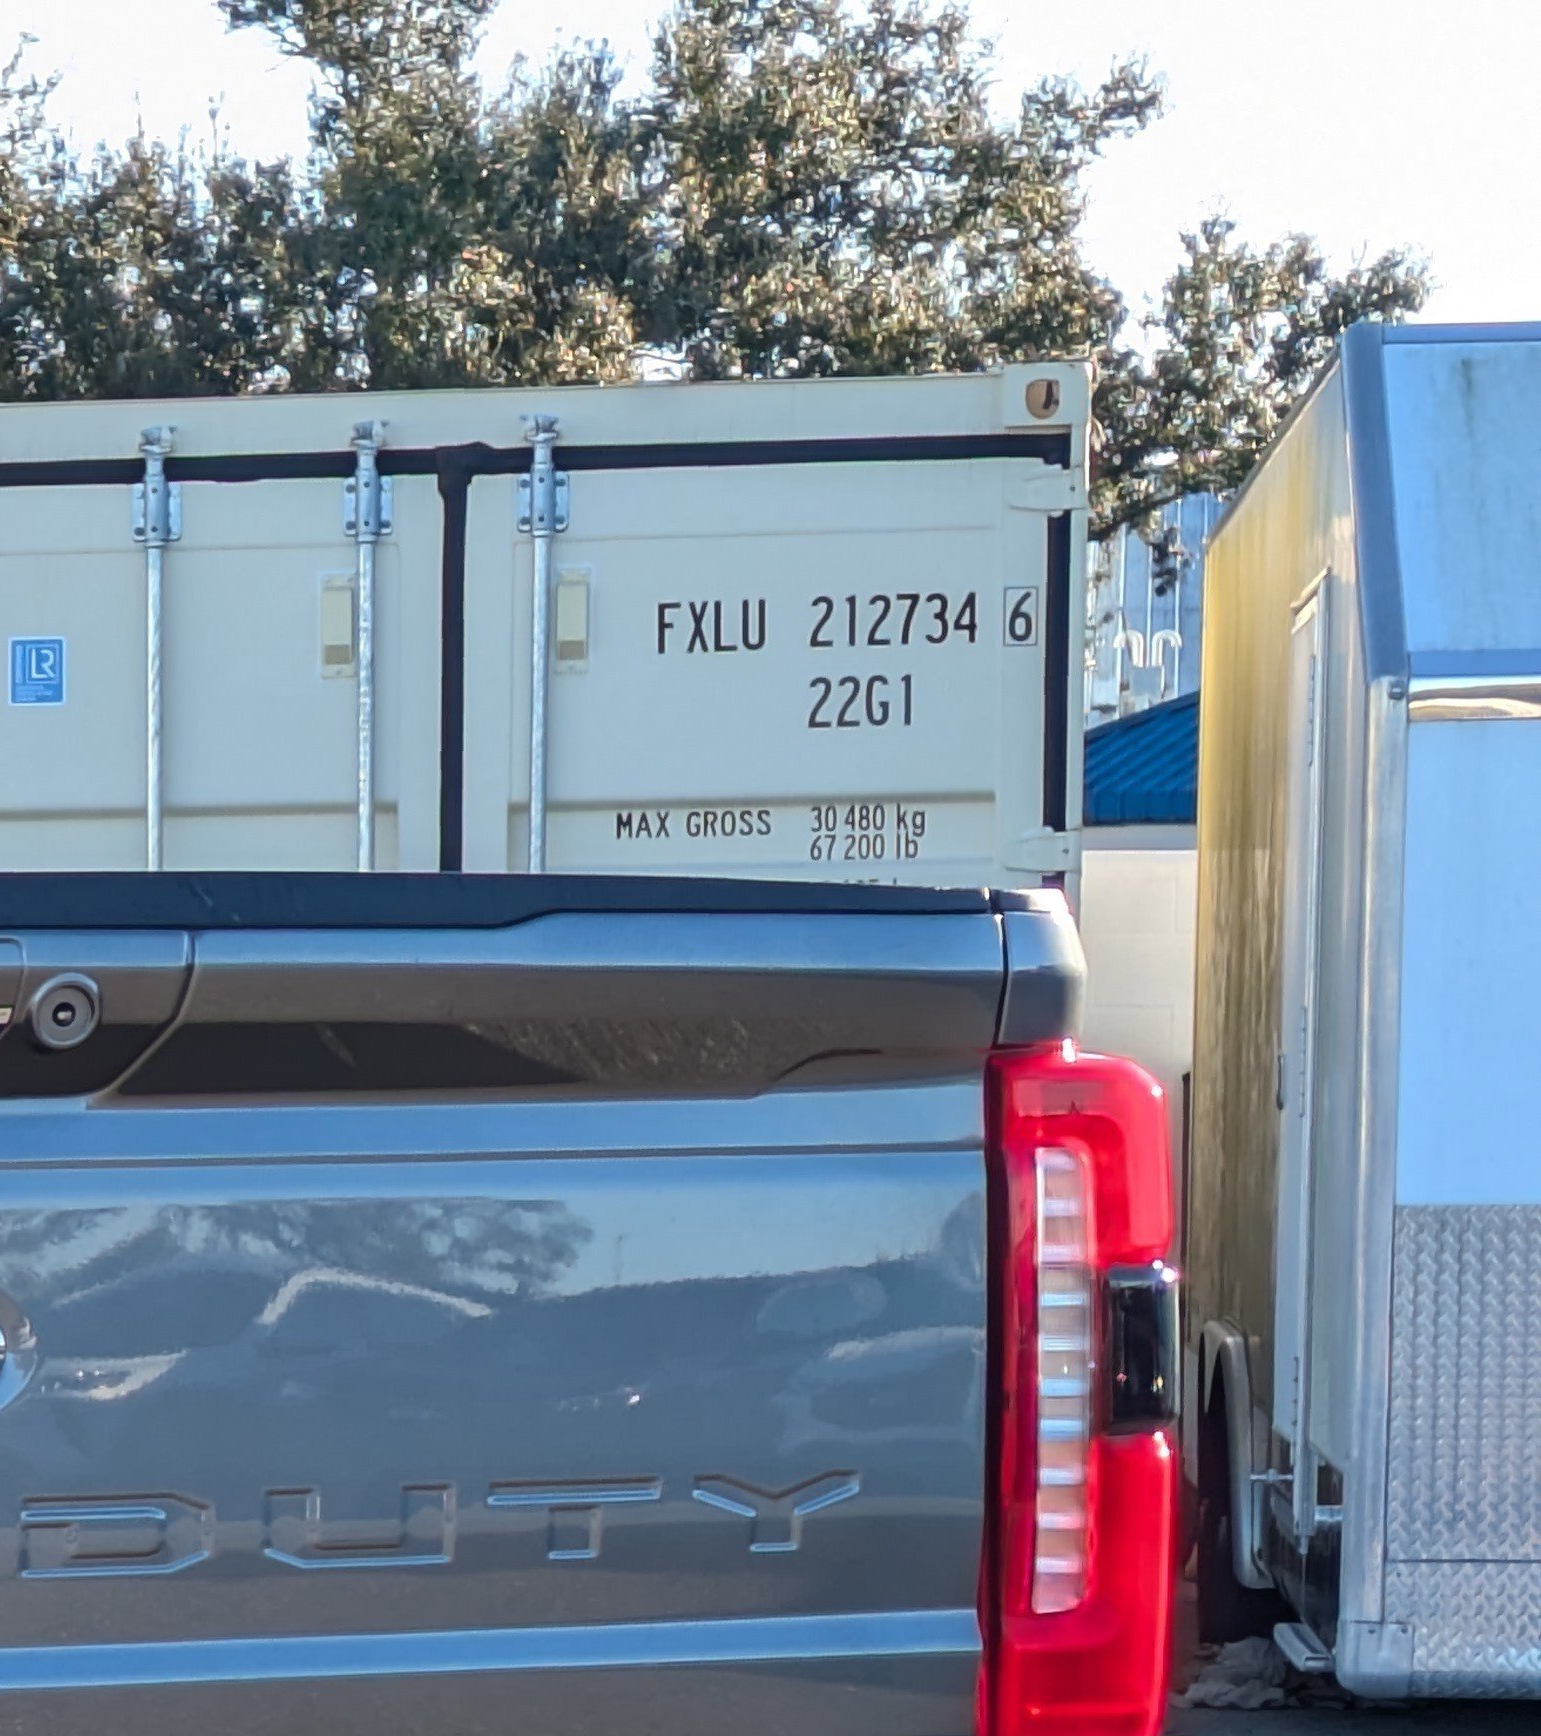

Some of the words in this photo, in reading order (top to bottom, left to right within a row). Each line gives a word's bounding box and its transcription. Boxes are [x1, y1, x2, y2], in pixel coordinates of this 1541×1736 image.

[657, 597, 766, 654] FXLU
[809, 591, 978, 647] 212734
[1006, 589, 1035, 644] 6
[808, 674, 913, 729] 22G1
[616, 811, 671, 840] MAX
[686, 809, 772, 838] GROSS
[811, 805, 837, 833] 30
[844, 803, 886, 832] 480
[896, 802, 926, 837] kg
[810, 834, 837, 861] 67
[844, 833, 886, 861] 200
[896, 833, 919, 860] lb
[19, 1467, 862, 1580] DUTY
